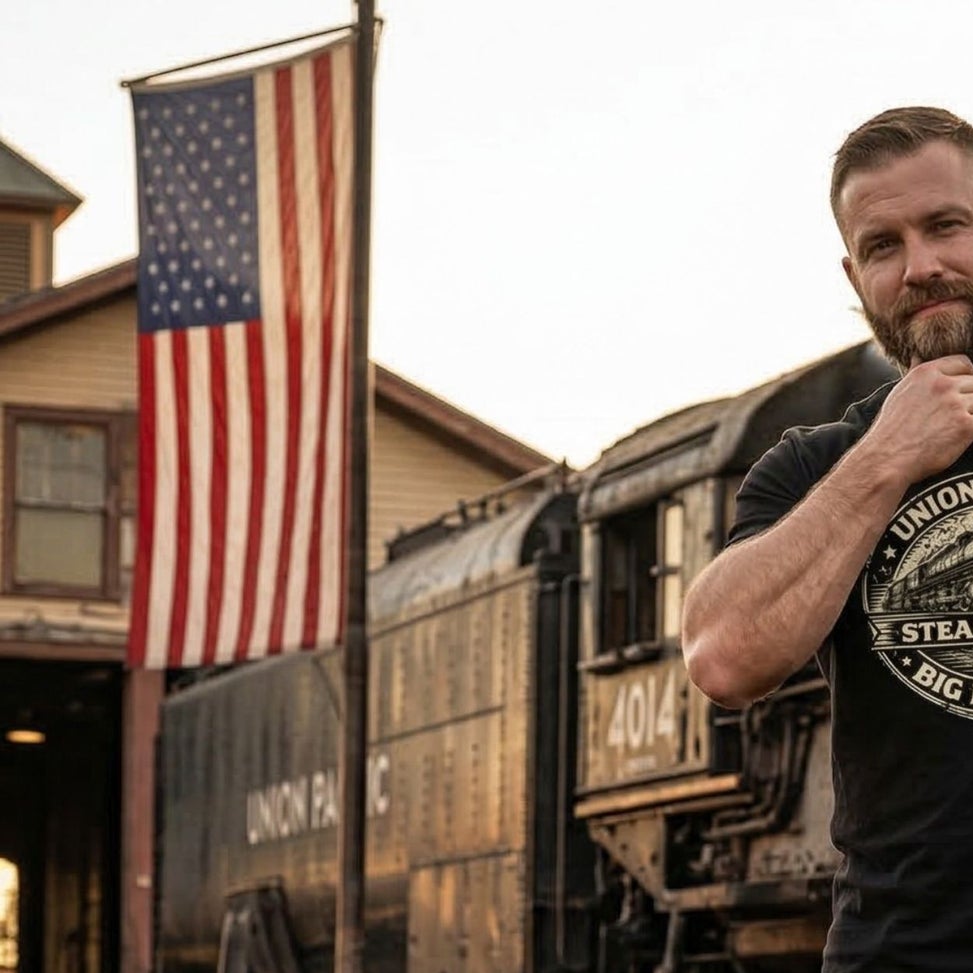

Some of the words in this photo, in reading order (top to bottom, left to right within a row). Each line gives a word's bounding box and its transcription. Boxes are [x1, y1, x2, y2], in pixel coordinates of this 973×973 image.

[607, 667, 676, 752] 4014
[911, 662, 963, 701] BIG
[247, 774, 309, 845] UNION
[311, 754, 390, 829] PAIC
